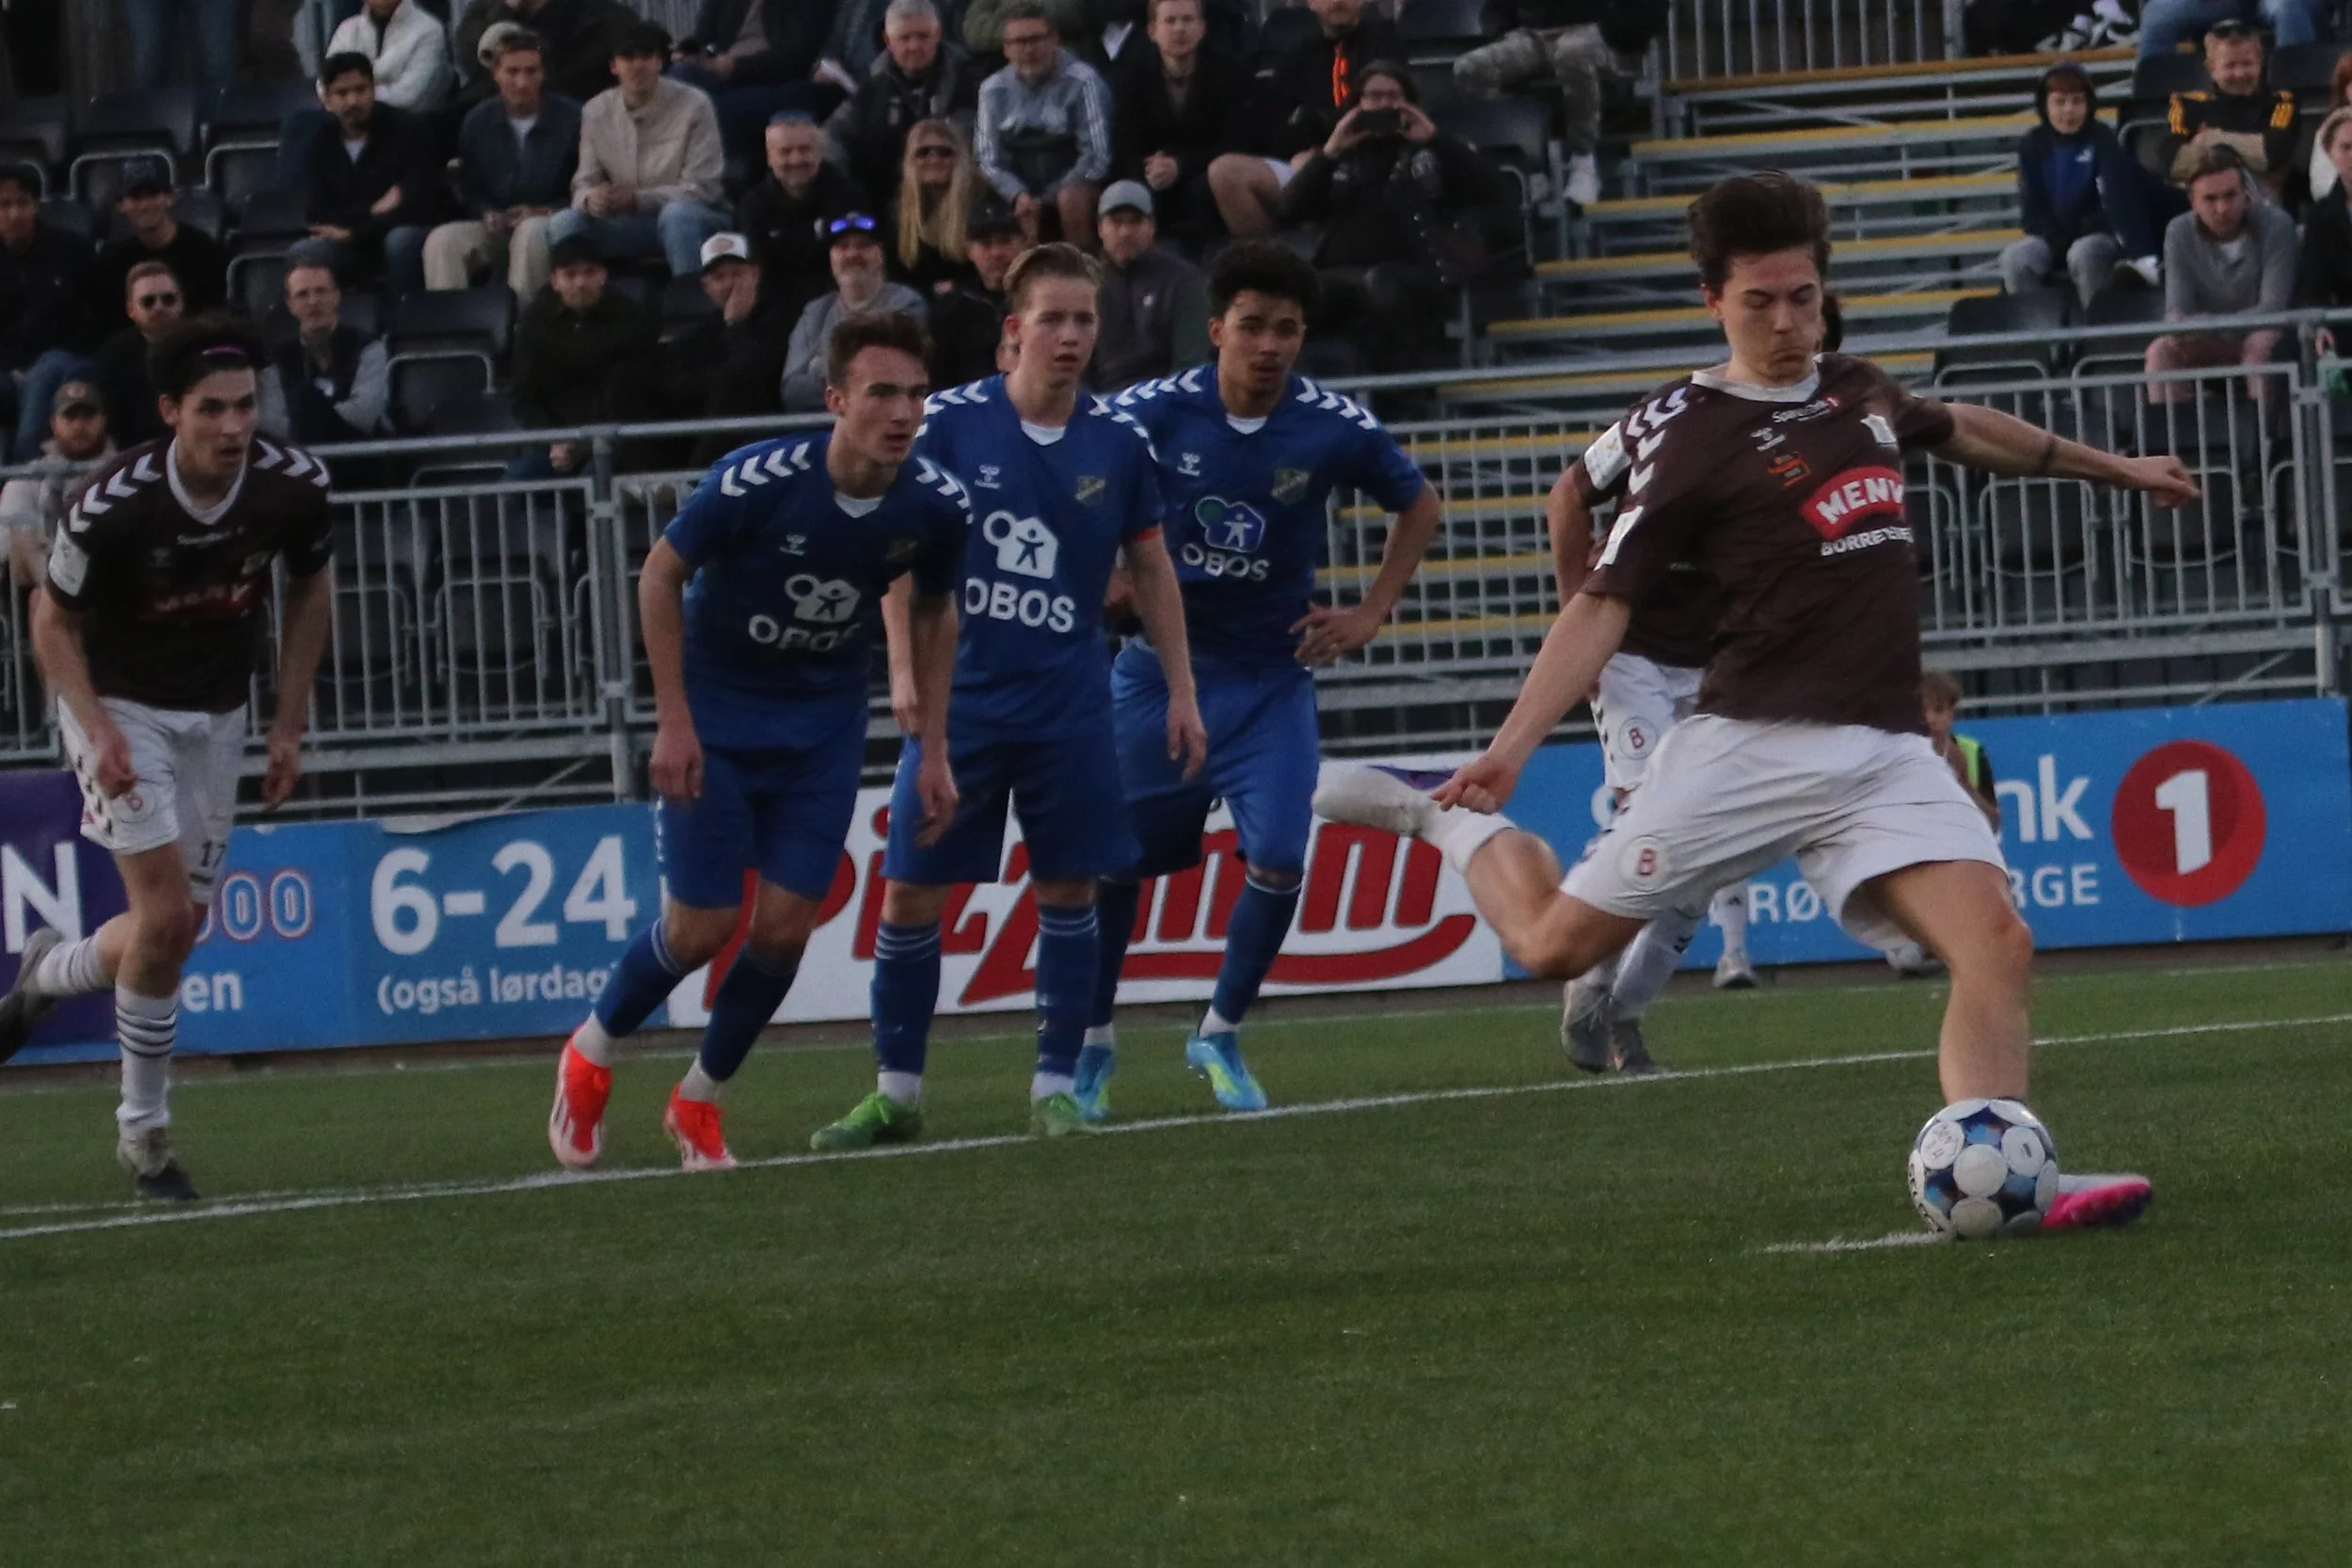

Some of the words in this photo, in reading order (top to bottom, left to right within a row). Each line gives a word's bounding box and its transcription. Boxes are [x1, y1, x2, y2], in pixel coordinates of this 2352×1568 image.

[1181, 542, 1270, 581] OBOS
[965, 577, 1077, 634] OBOS
[1629, 727, 1645, 750] B
[1637, 847, 1657, 877] B
[195, 869, 313, 942] 00
[371, 835, 638, 956] 6-24
[376, 965, 482, 1016] (også
[489, 961, 619, 1004] lørdag
